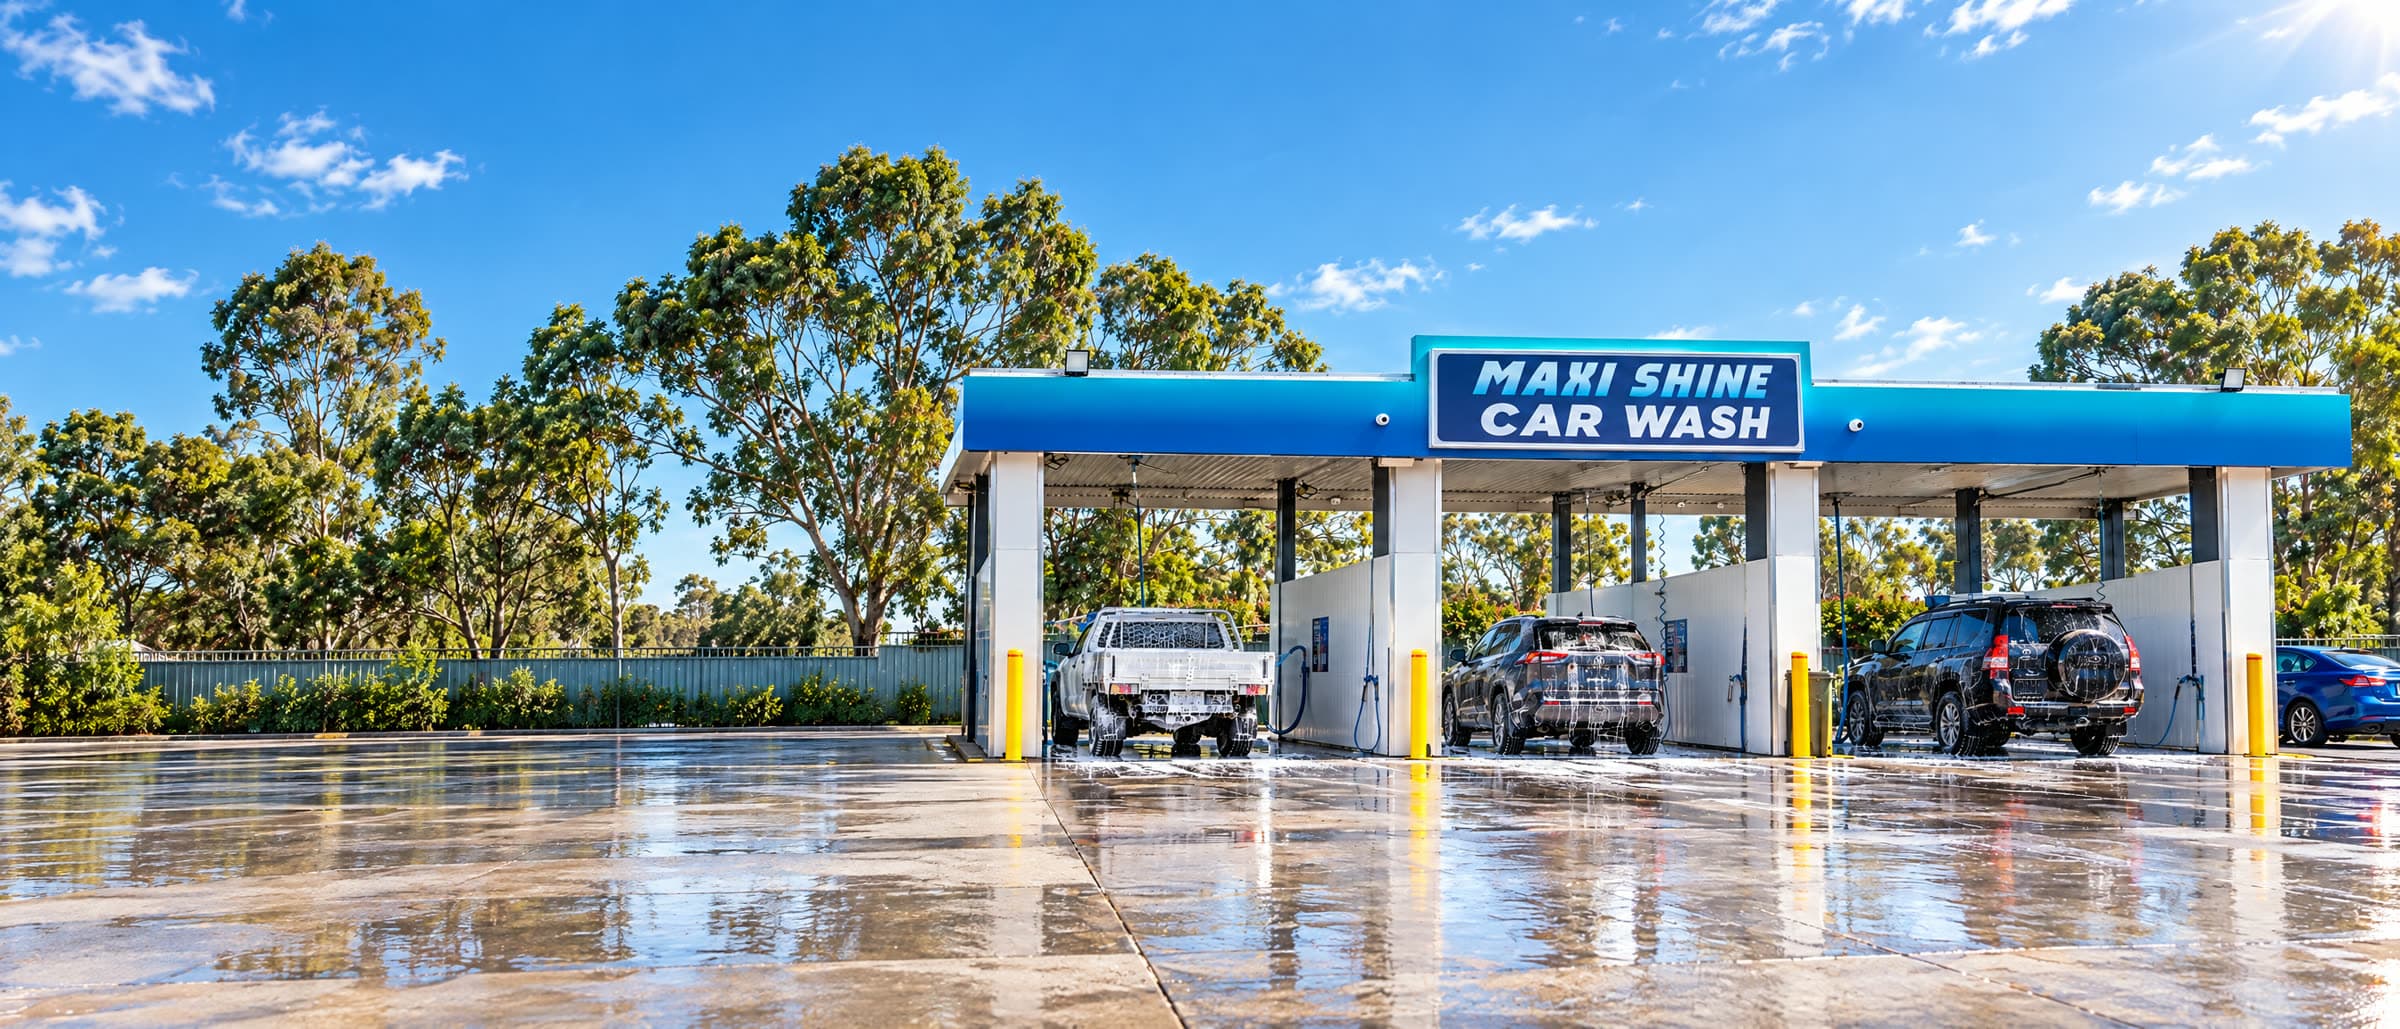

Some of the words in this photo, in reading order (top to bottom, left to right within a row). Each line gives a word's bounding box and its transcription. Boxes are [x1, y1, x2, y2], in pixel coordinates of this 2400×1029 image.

[1472, 360, 1617, 397] MAXI
[1629, 362, 1774, 399] SHINE
[1480, 402, 1603, 438] CAR
[1624, 404, 1771, 440] WASH
